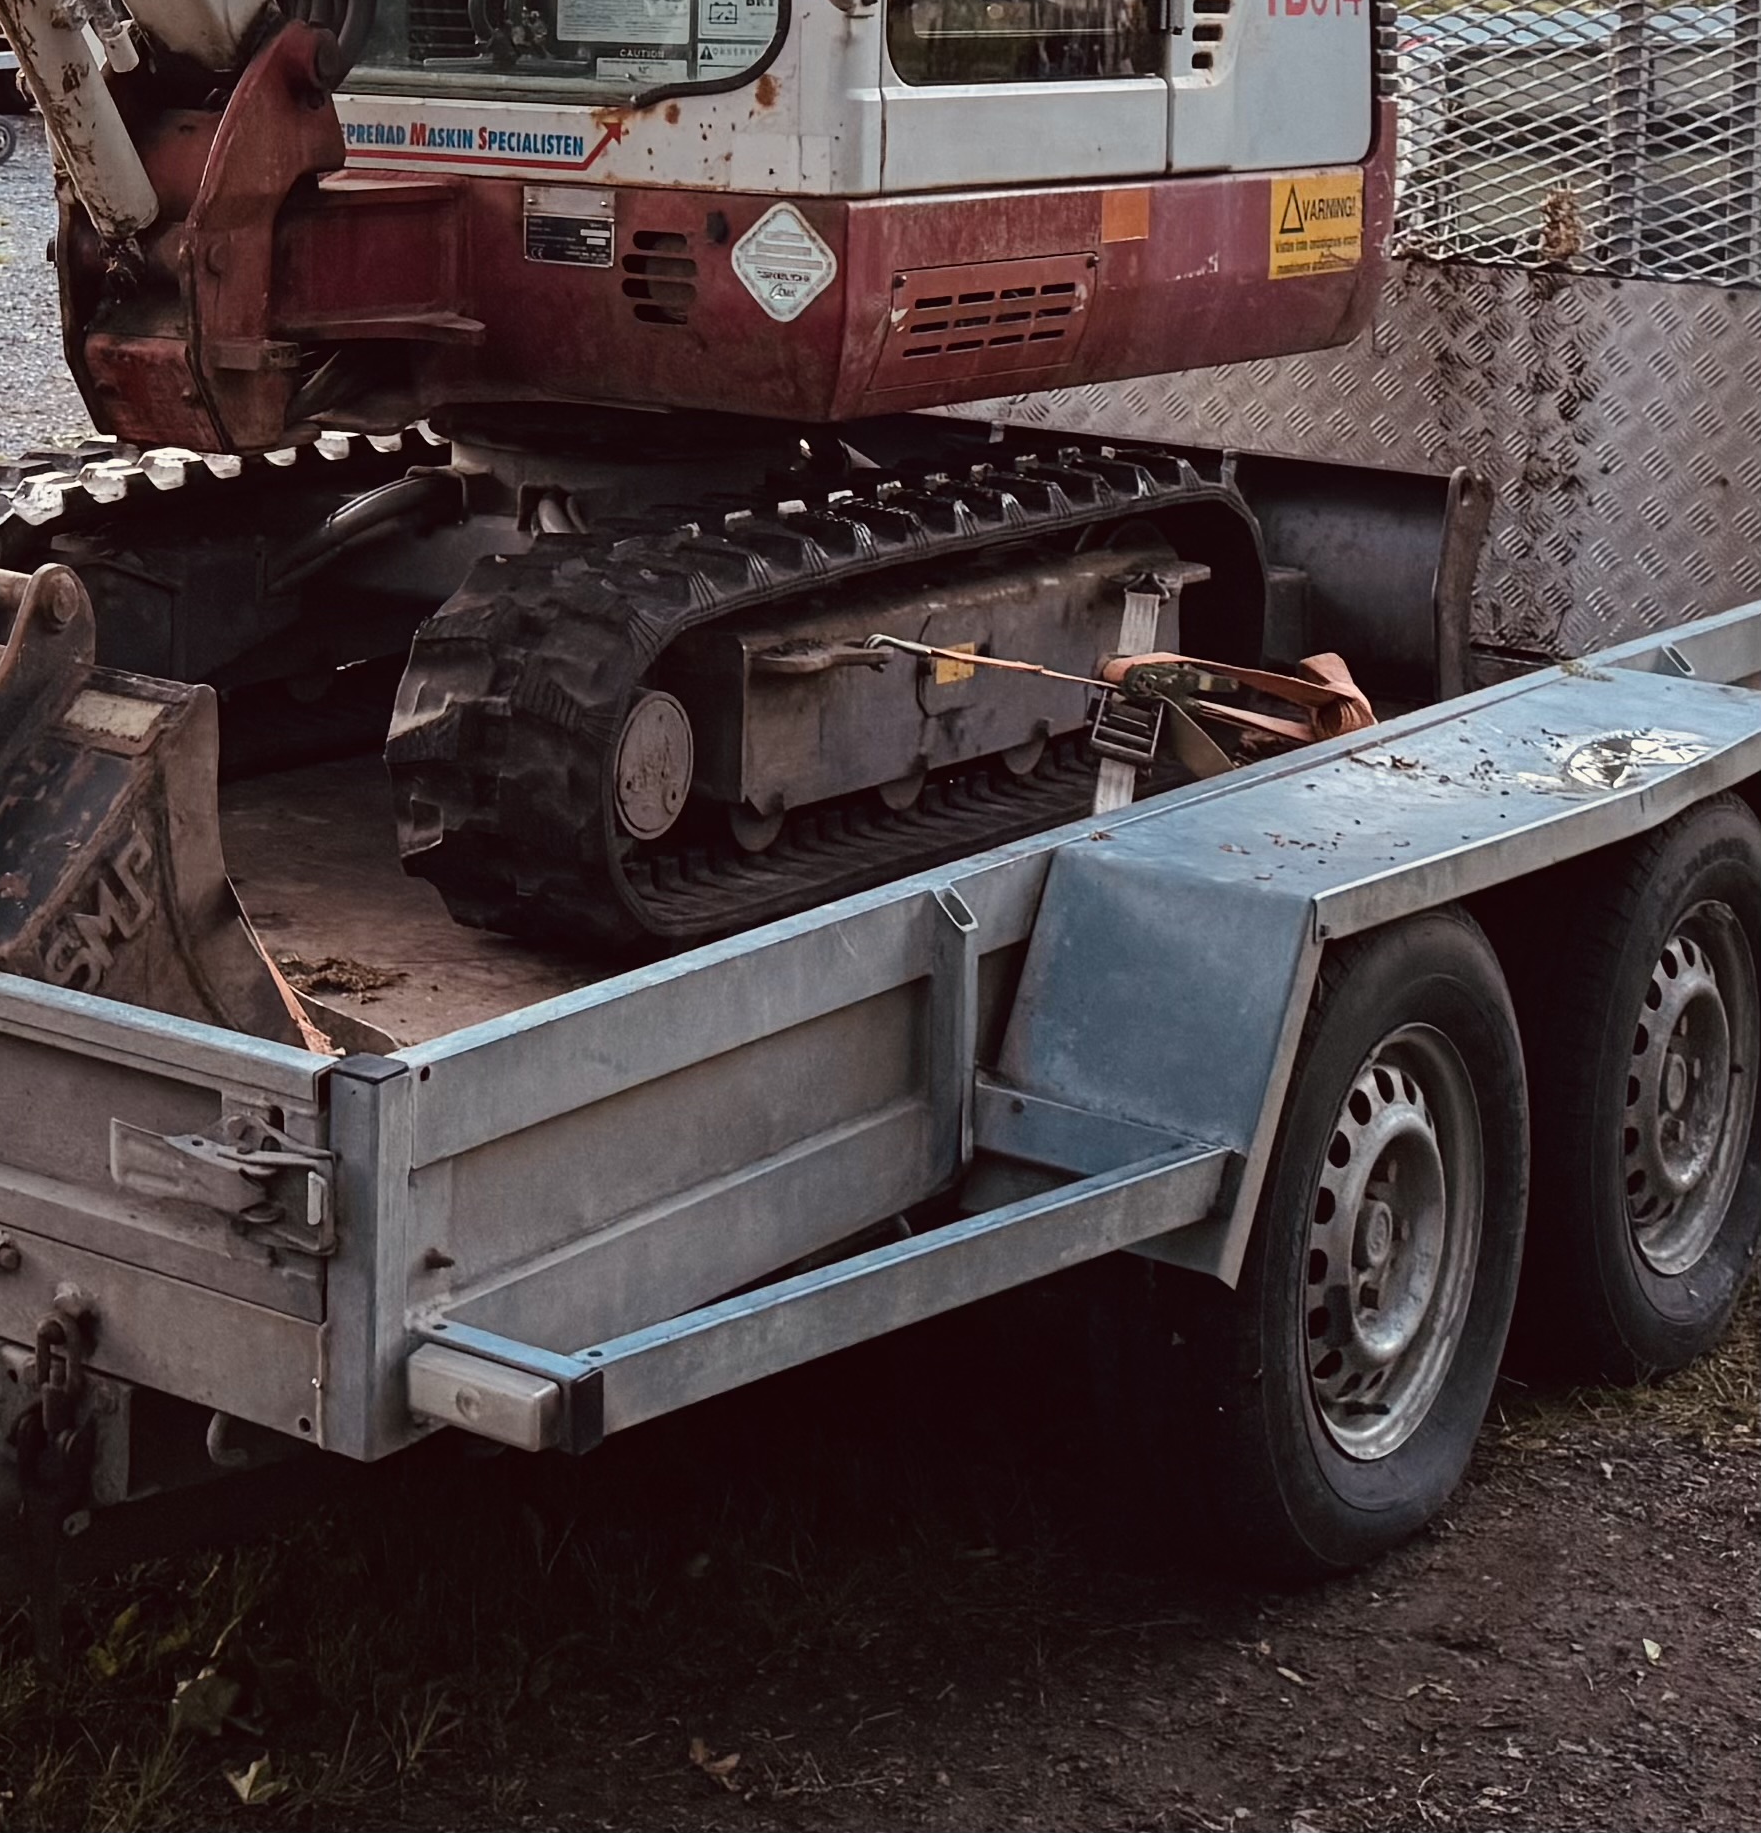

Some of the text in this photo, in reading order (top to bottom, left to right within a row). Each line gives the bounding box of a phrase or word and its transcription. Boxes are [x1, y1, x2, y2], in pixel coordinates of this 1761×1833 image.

[619, 48, 665, 59] CAUTION
[340, 122, 584, 157] PRENAD MASKIN SPECIALISTEN
